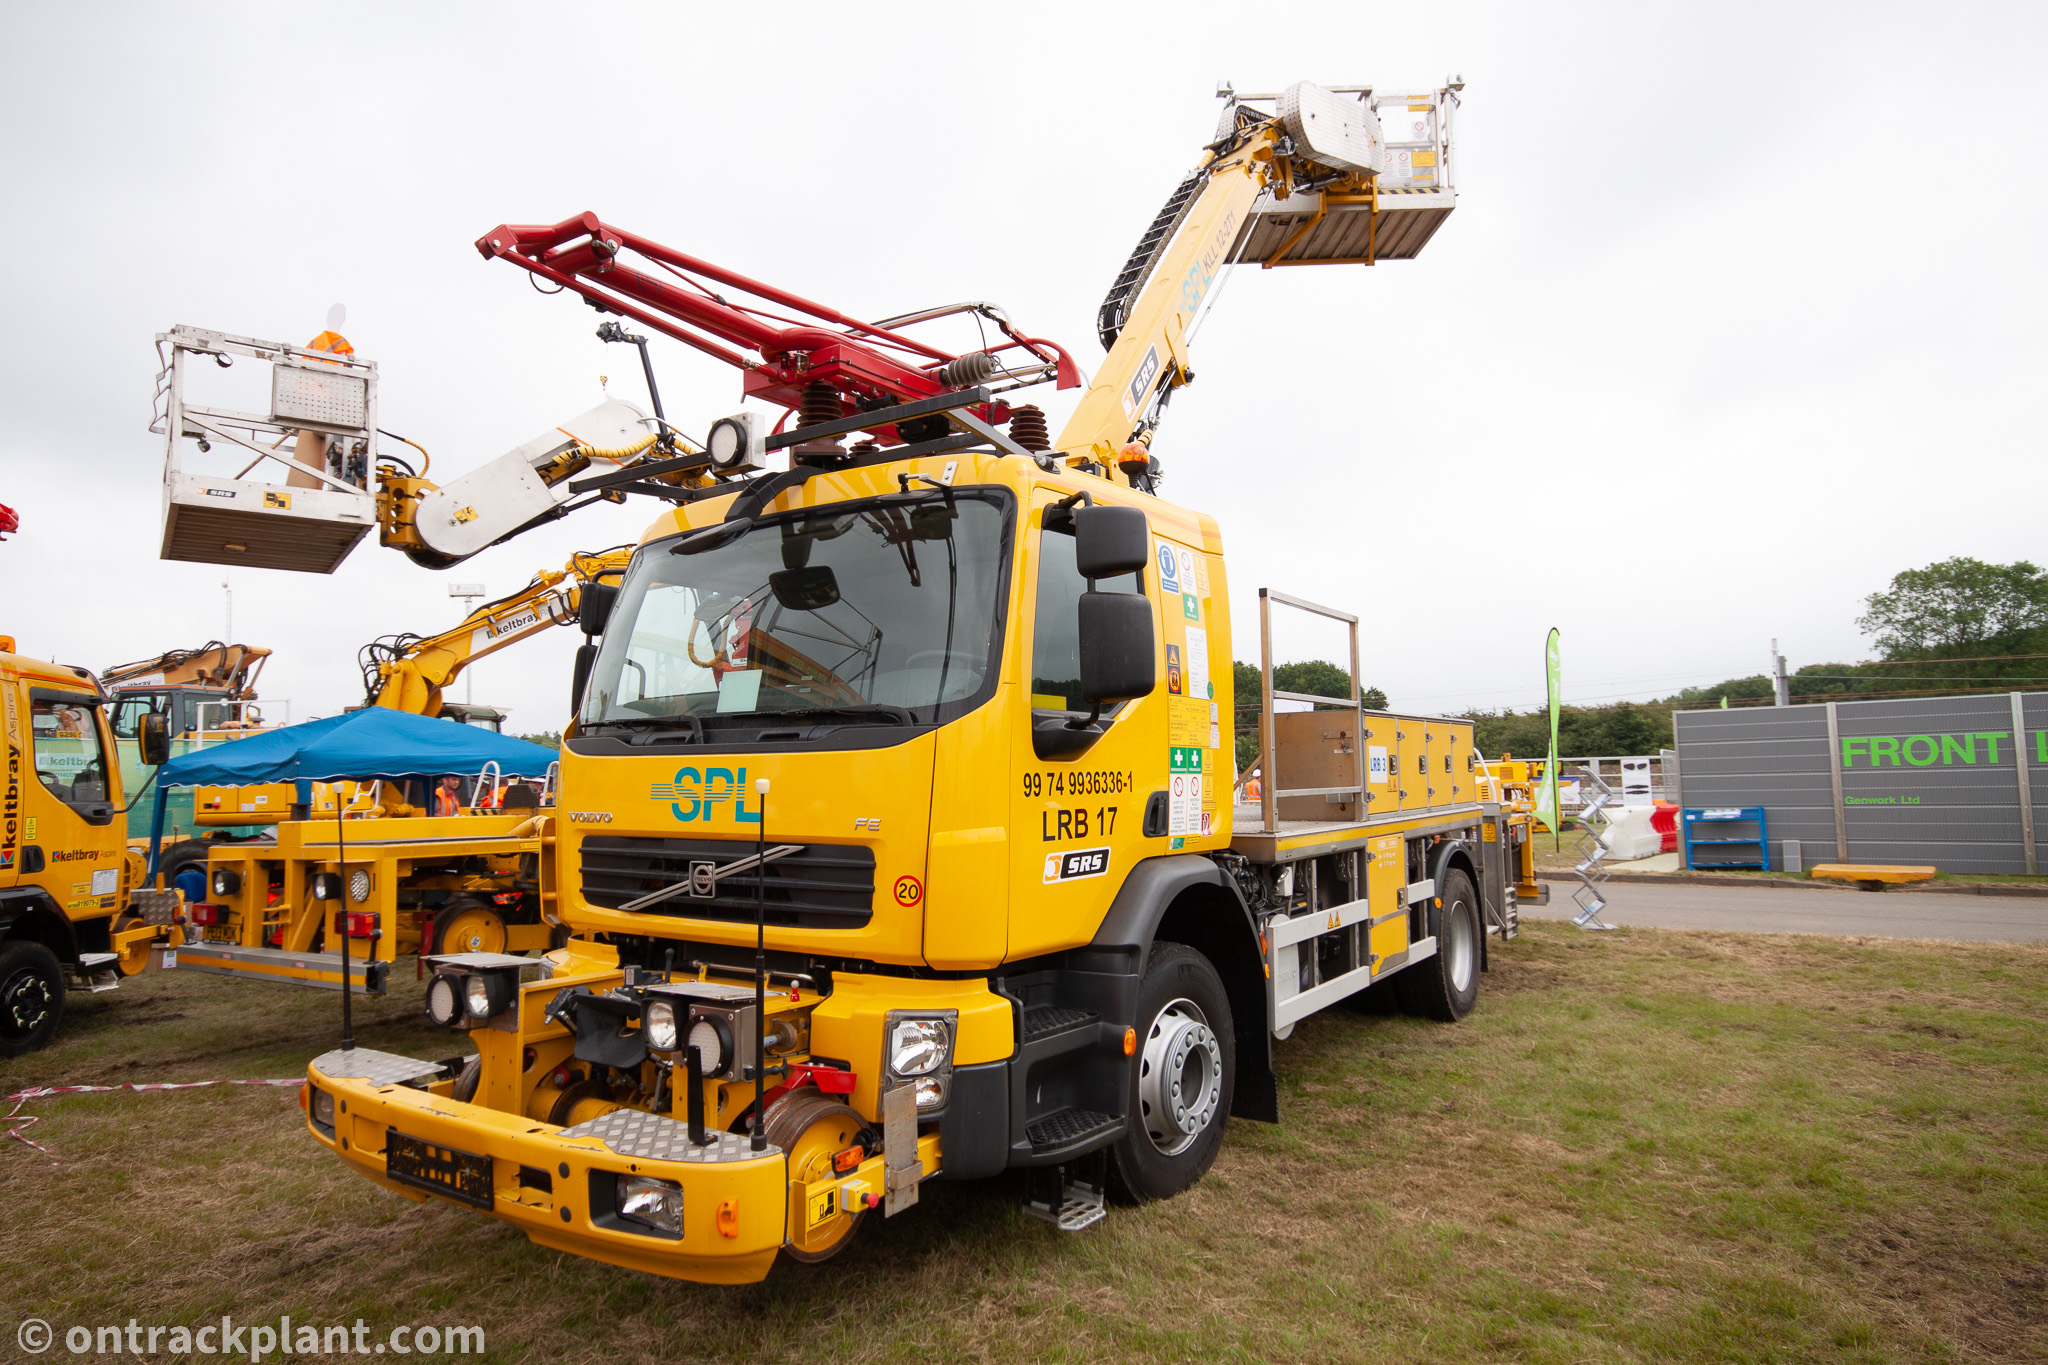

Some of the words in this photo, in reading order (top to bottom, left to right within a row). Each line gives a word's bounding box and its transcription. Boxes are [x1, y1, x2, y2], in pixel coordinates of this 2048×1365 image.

[1202, 245, 1219, 274] KLL
[1180, 259, 1211, 313] SPL
[1135, 354, 1156, 397] SRS
[209, 489, 233, 497] SRS
[496, 613, 538, 635] keltbray
[8, 693, 18, 741] Aspire
[1842, 732, 2009, 767] FRONT
[2, 744, 20, 849] keltbray
[671, 766, 761, 823] SPL
[1023, 772, 1042, 798] 99
[1046, 771, 1065, 797] 74
[1068, 771, 1133, 795] 9936336-1
[1844, 796, 1896, 805] Genwork
[1900, 796, 1921, 805] Ltd
[568, 811, 613, 823] VOLVO
[854, 817, 881, 832] FE
[1042, 808, 1089, 842] LRB
[1096, 806, 1118, 836] 17
[60, 849, 100, 863] keltbray
[1067, 853, 1103, 874] SRS
[898, 882, 919, 900] 20
